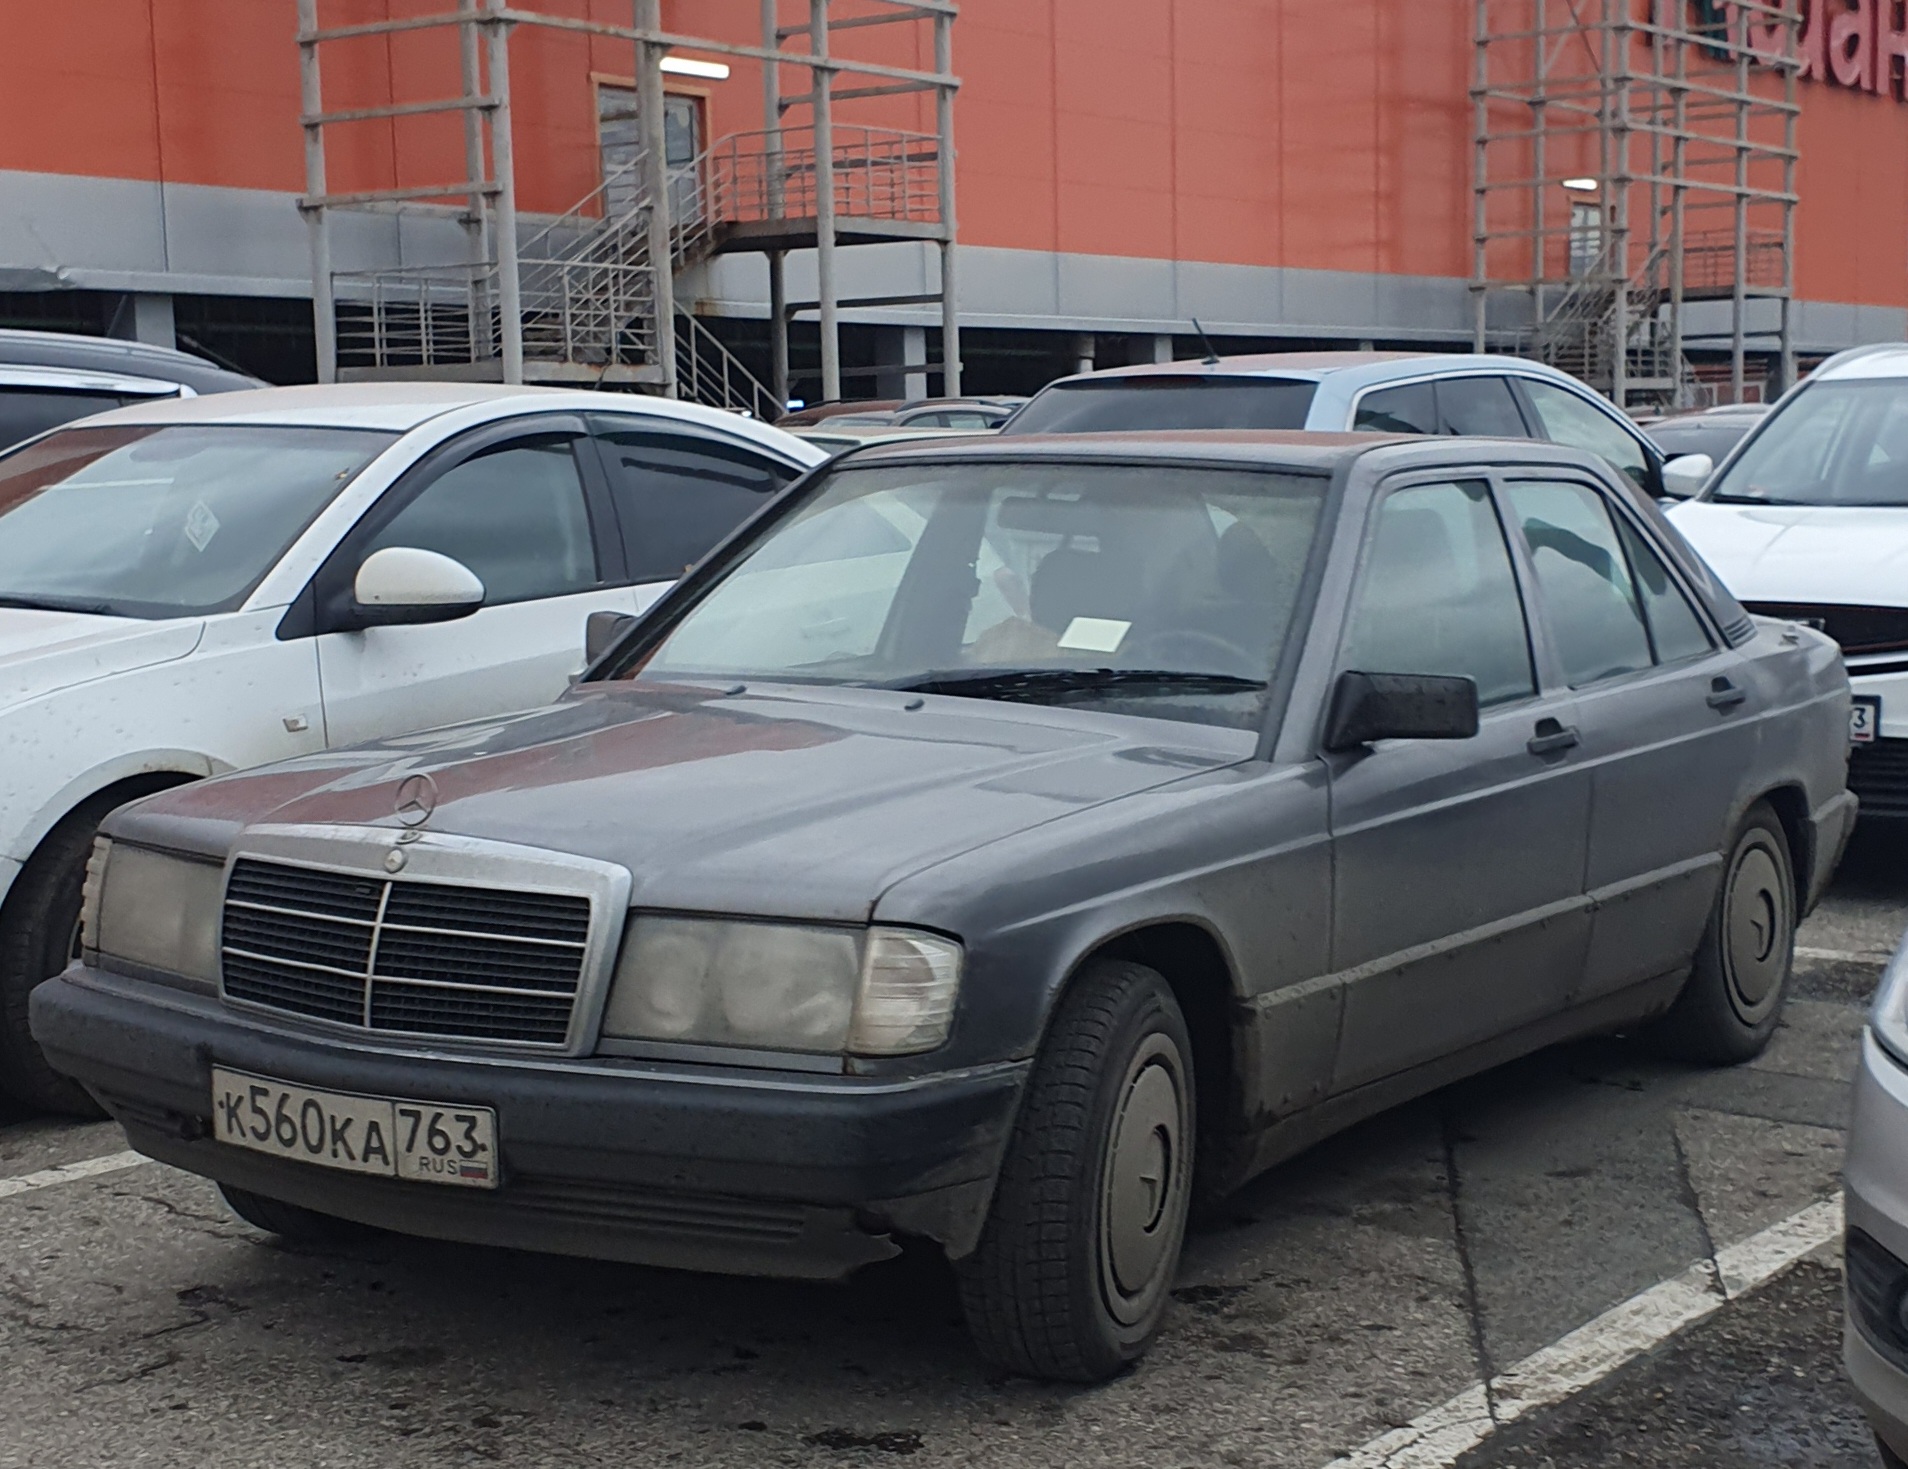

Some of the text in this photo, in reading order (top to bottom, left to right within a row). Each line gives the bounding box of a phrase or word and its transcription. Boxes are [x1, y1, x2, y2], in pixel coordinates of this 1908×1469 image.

[224, 1085, 478, 1167] К560КА 763
[419, 1156, 458, 1176] RUS
